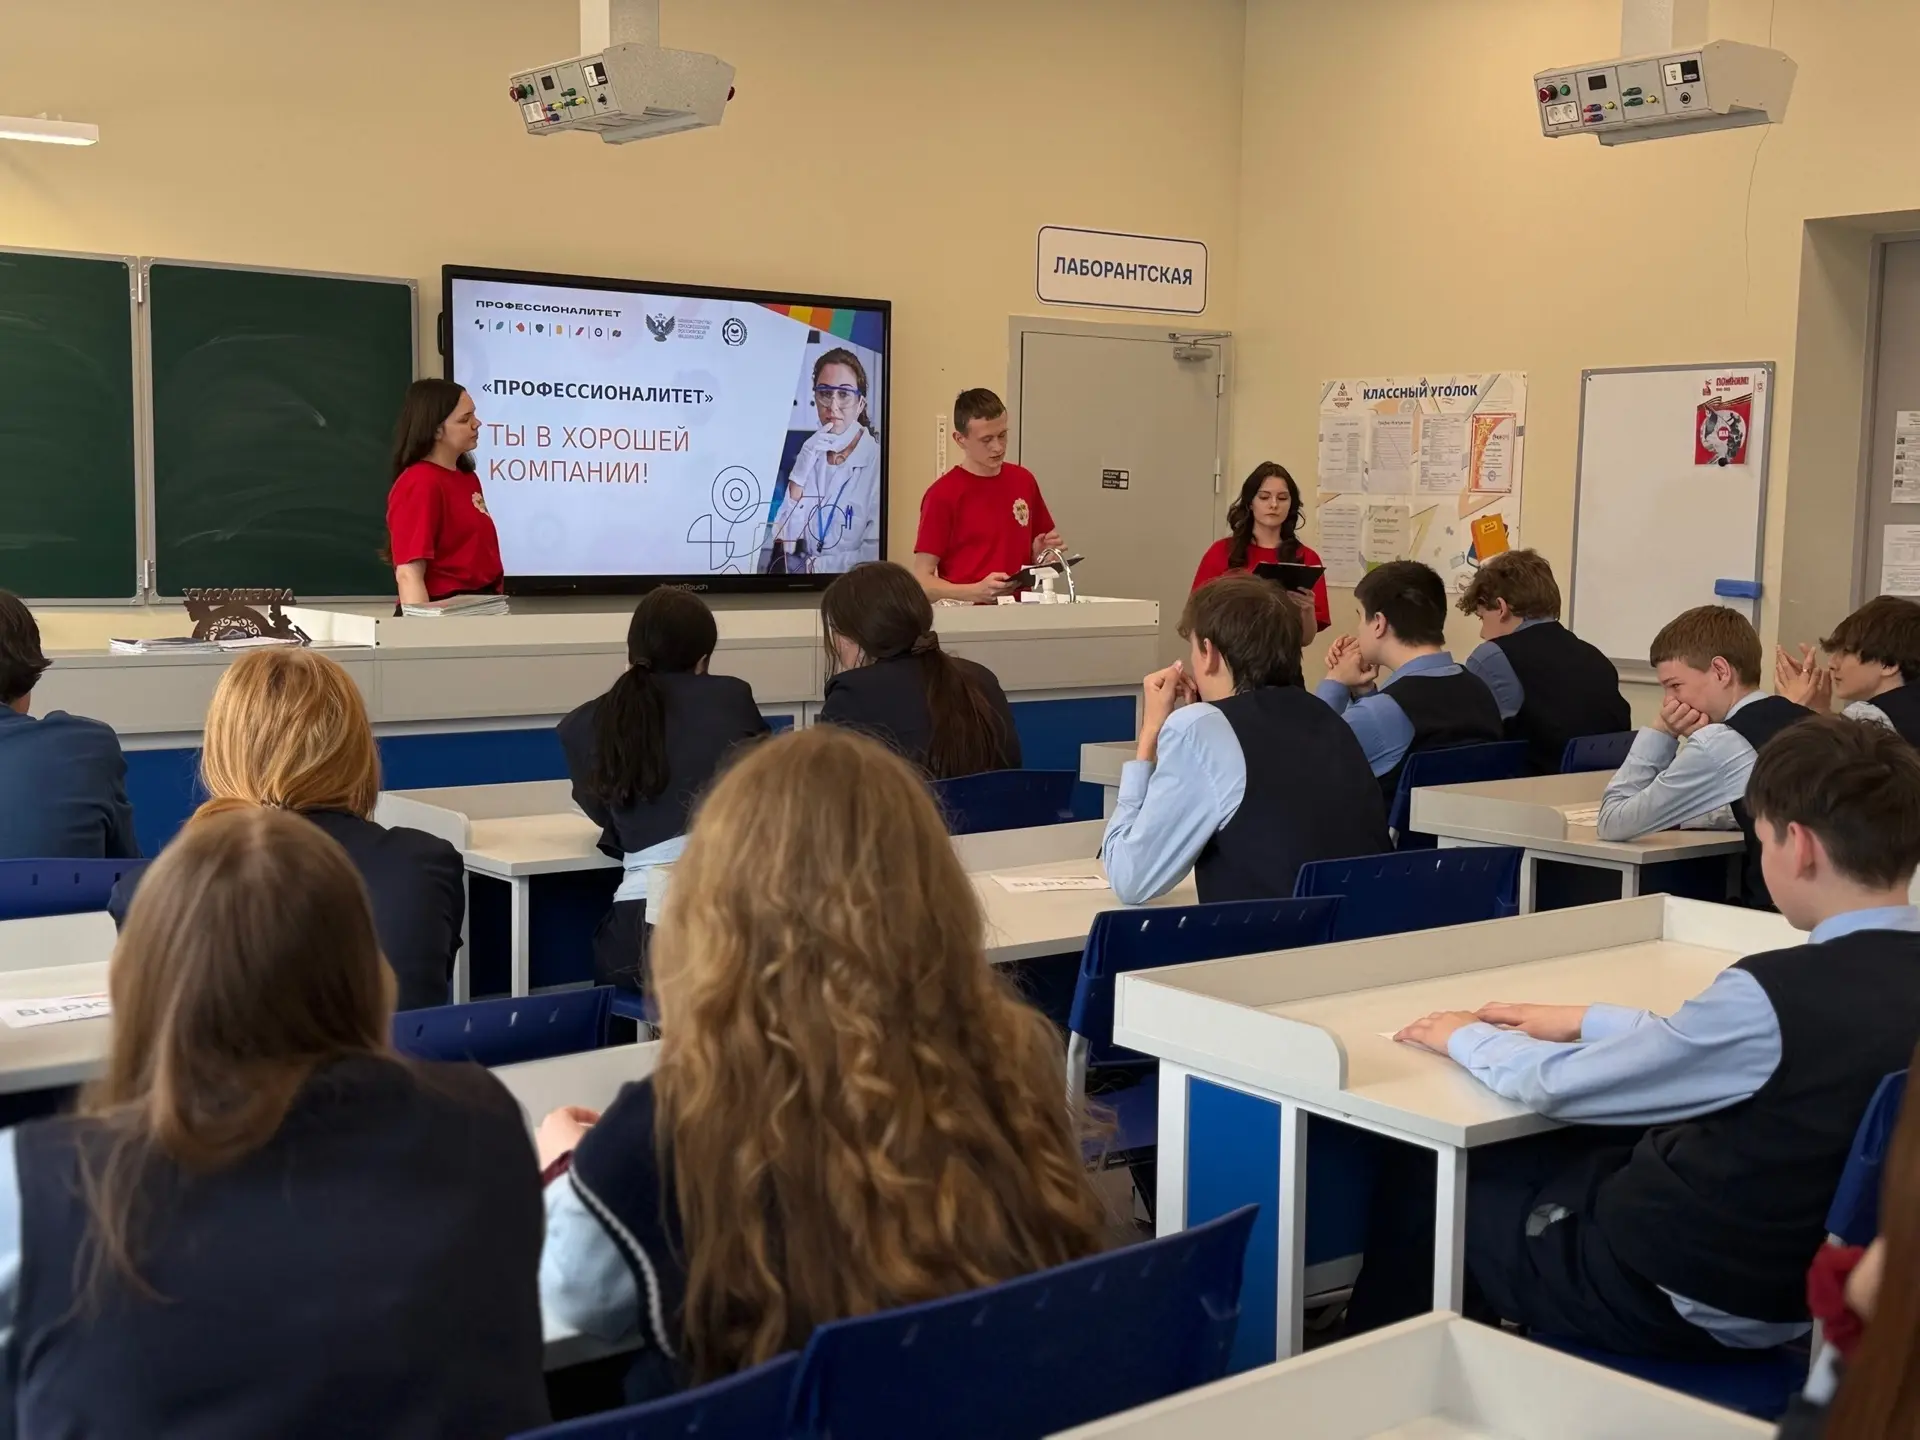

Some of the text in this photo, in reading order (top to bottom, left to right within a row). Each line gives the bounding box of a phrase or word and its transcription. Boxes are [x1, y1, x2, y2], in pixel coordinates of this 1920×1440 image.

[1054, 256, 1193, 285] ЛАБОРАНТСКАЯ
[475, 300, 622, 317] ПРОФЕССИОНАЛИТЕТ
[482, 379, 714, 404] «ПРОФЕССИОНАЛИТЕТ»
[1363, 384, 1428, 400] КЛАССНЫЙ
[1430, 384, 1478, 397] УГОЛОК
[487, 423, 690, 452] ТЫ В ХОРОШЕЙ
[489, 459, 650, 485] КОМПАНИИ!
